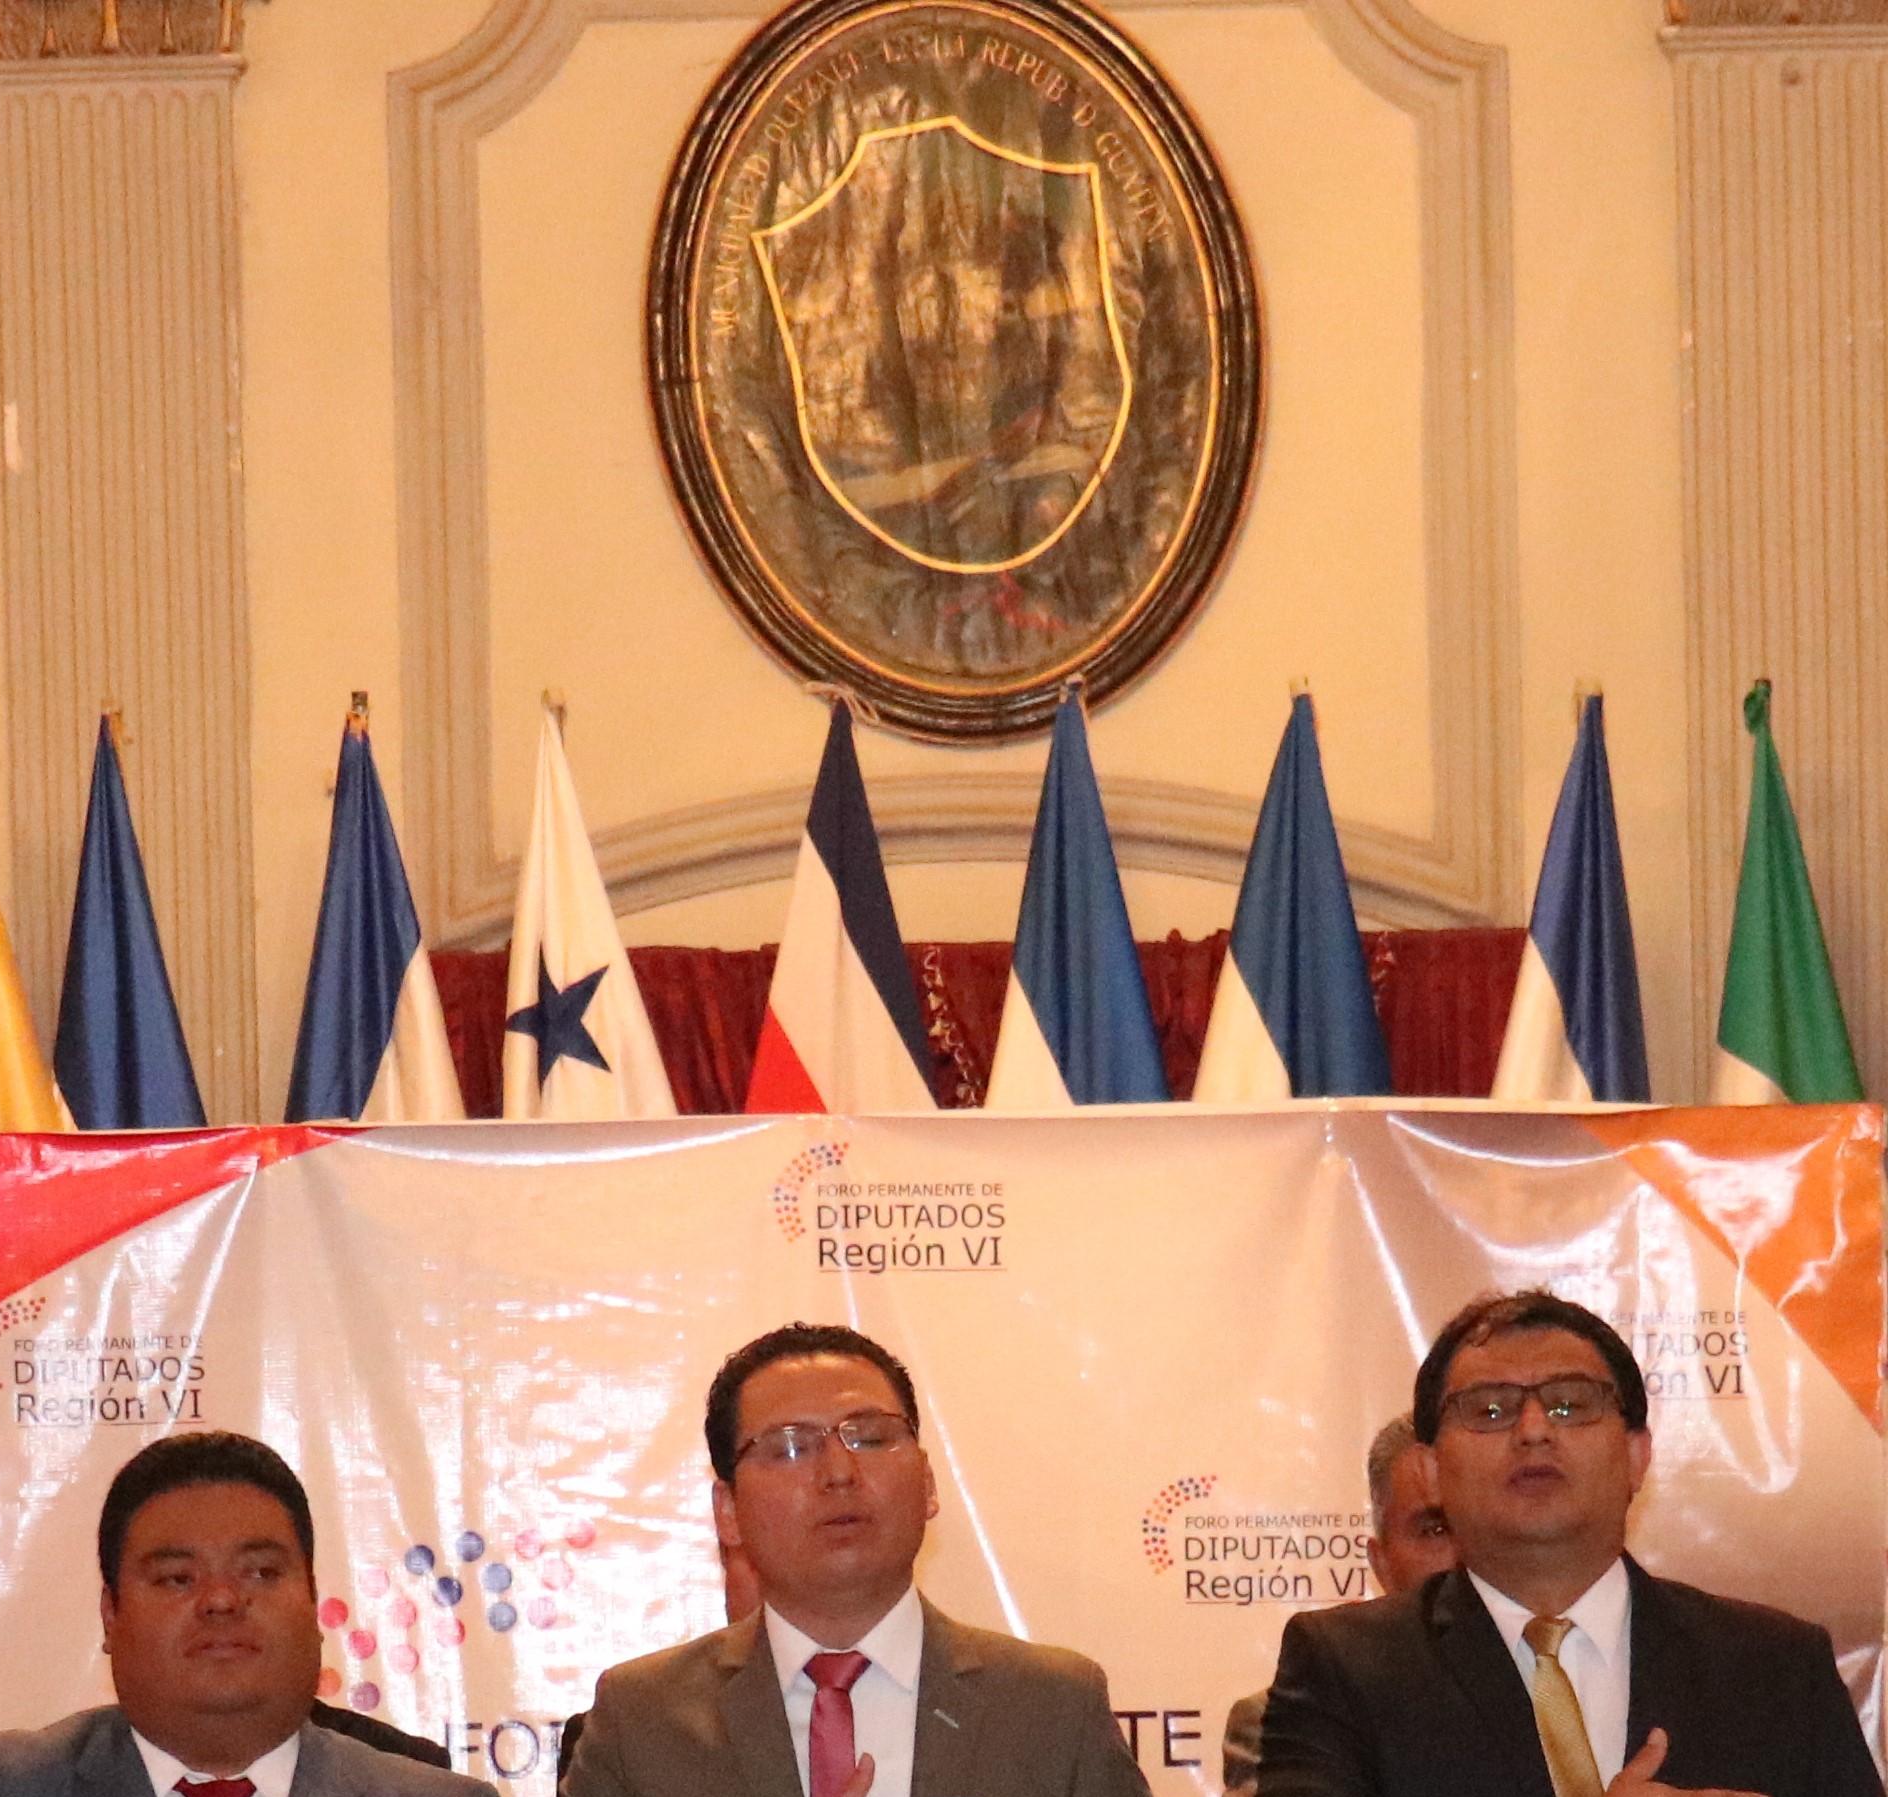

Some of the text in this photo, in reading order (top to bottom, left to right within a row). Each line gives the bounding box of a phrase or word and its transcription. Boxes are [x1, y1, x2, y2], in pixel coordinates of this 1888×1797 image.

[816, 1182, 1004, 1198] FORO PERMANENTE DE
[815, 1203, 1006, 1231] DIPUTADOS
[817, 1233, 1002, 1274] Región VI
[13, 1355, 206, 1385] DIPUTADOS
[1704, 1364, 1746, 1395] VI
[15, 1386, 203, 1422] Región VI
[1184, 1515, 1230, 1530] FORO
[1235, 1514, 1343, 1530] PERMANENTE
[1185, 1564, 1370, 1606] Región VI
